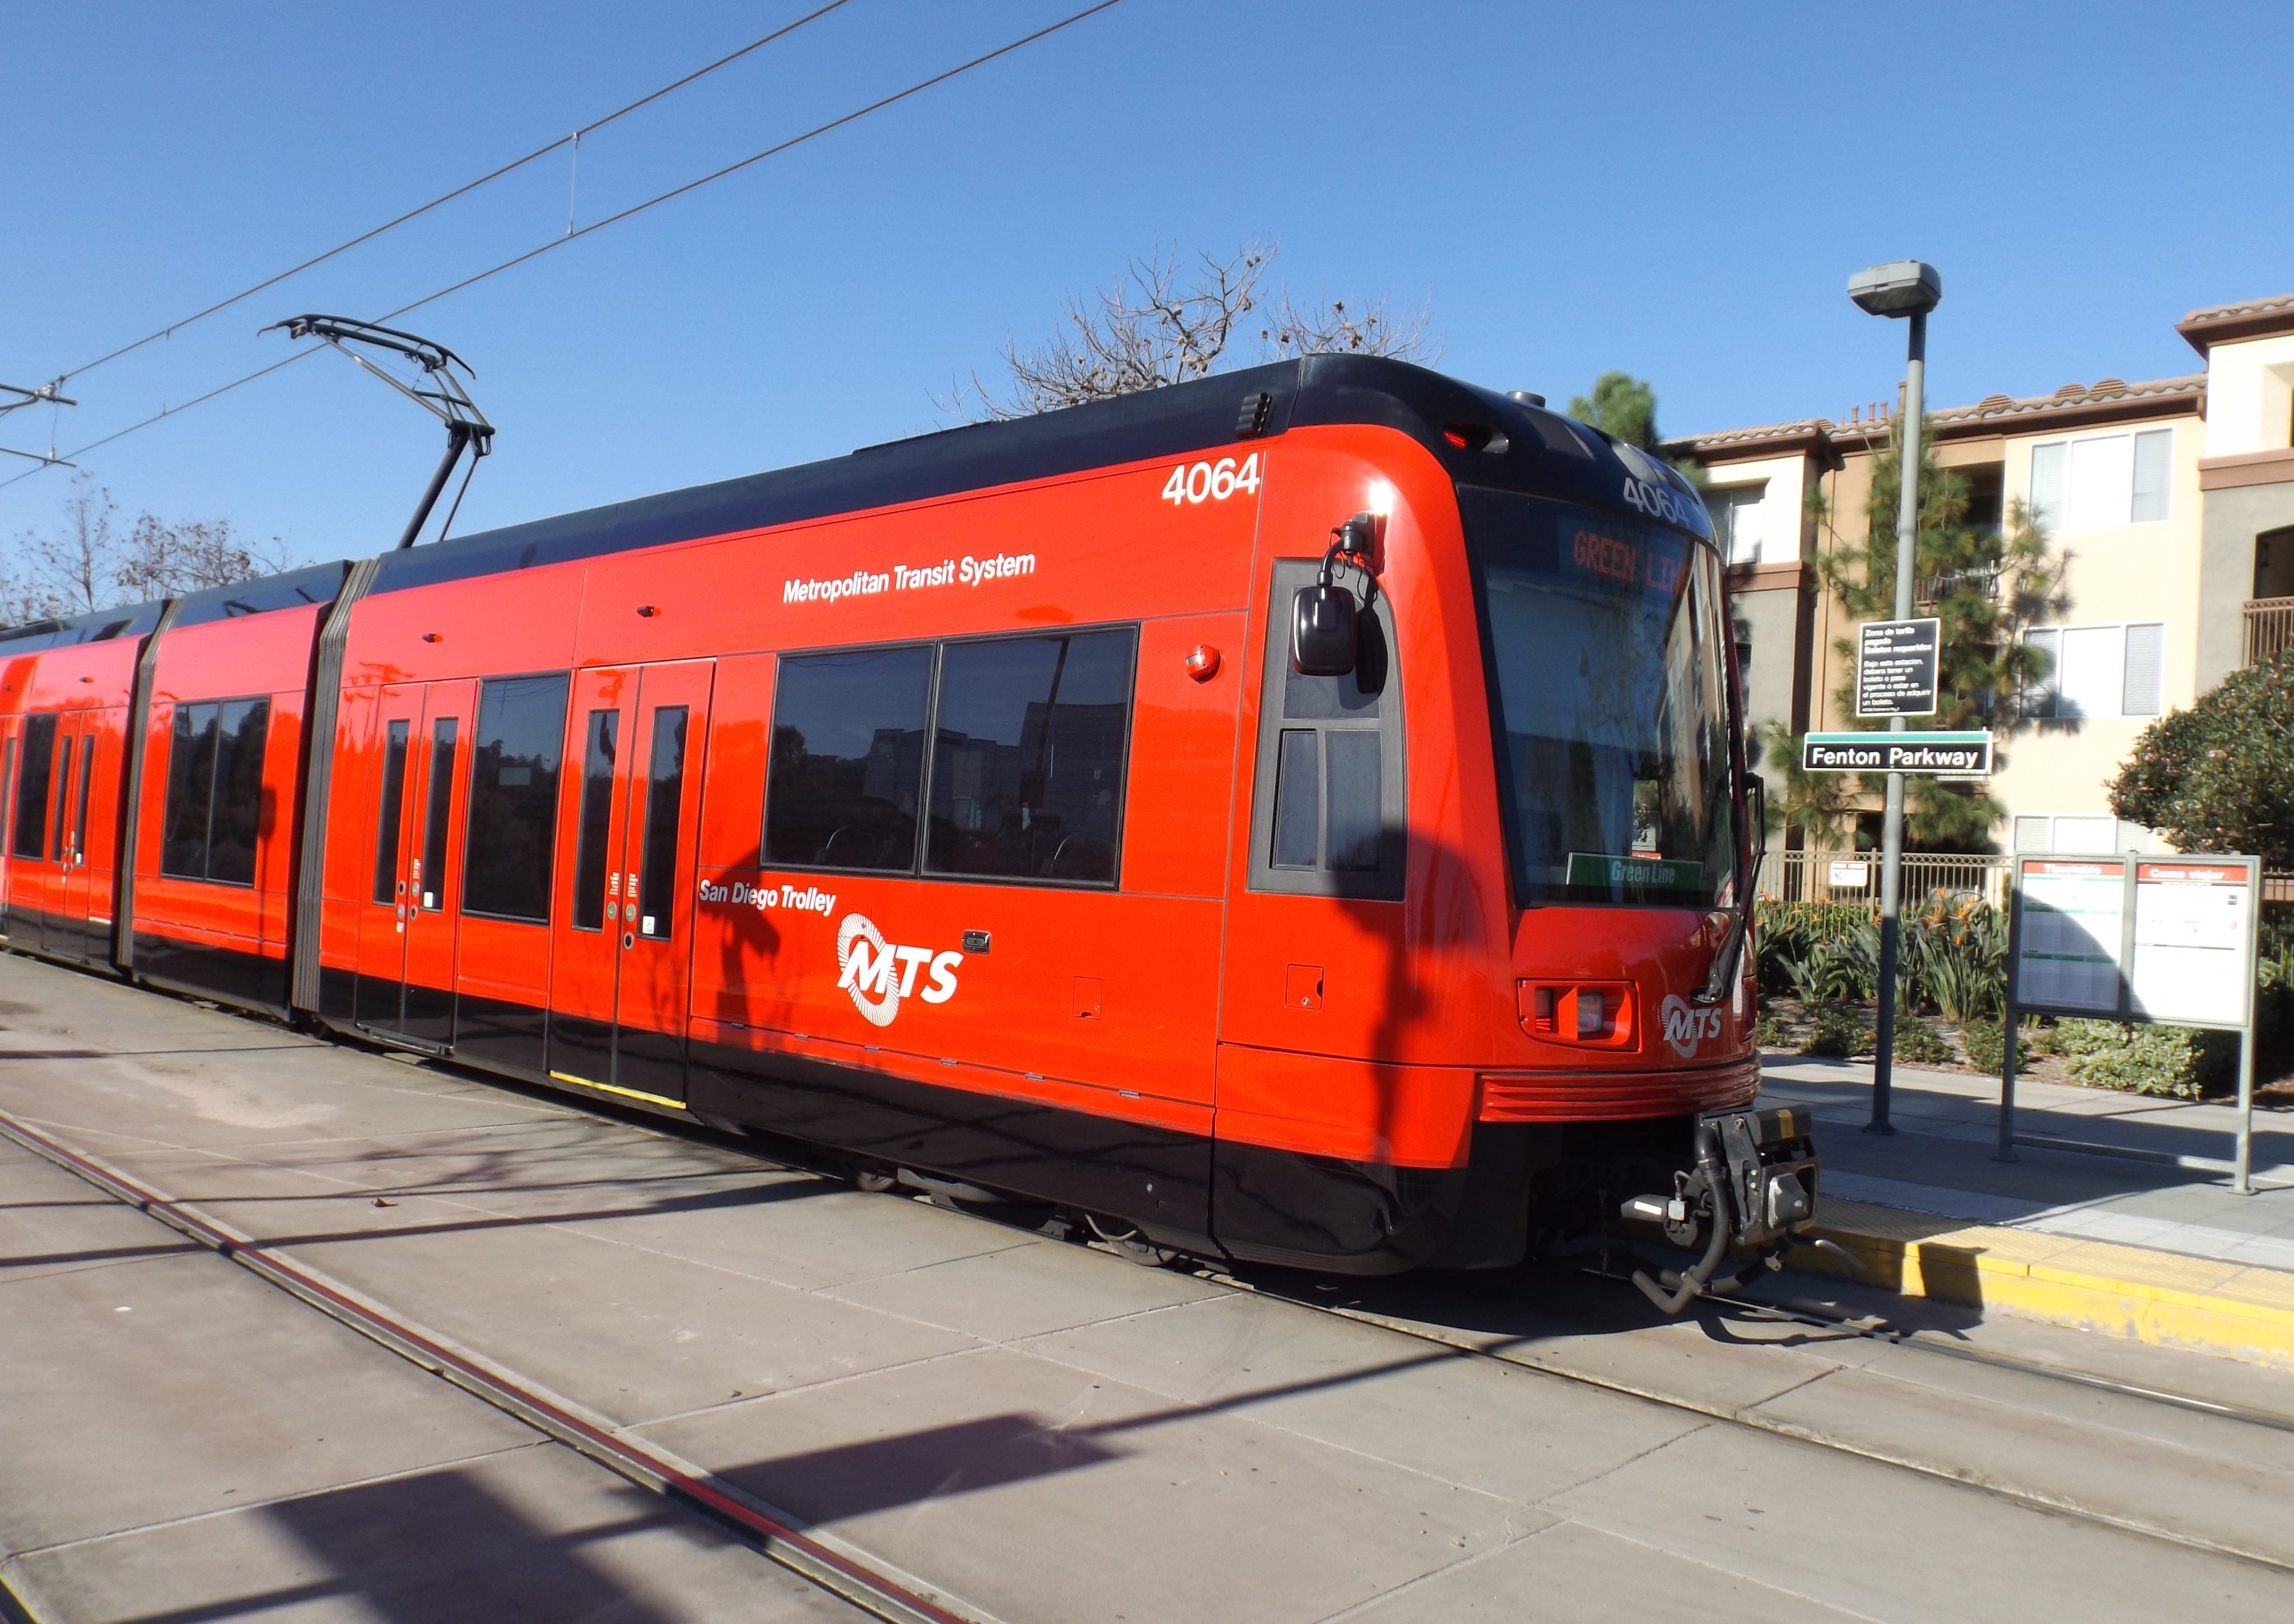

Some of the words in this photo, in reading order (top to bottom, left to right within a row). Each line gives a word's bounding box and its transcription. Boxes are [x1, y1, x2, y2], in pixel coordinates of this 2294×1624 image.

[1162, 452, 1260, 506] 4064
[1623, 477, 1690, 529] 4064
[783, 571, 889, 603] Metropolitan
[894, 559, 956, 590] Transit
[959, 553, 1036, 586] System
[1573, 530, 1638, 581] GREEN
[1645, 552, 1685, 596] LIN
[1864, 646, 1892, 654] Boletos
[1893, 643, 1932, 653] requeridos
[1812, 747, 1880, 765] Fenton
[1889, 747, 1978, 769] Parkway
[1611, 860, 1649, 883] Green
[1652, 863, 1675, 884] Line
[2044, 864, 2102, 875] Timetable
[2150, 868, 2186, 879] Como
[2189, 869, 2225, 881] viajar
[700, 879, 728, 903] San
[731, 882, 777, 911] Diego
[781, 885, 837, 917] Trolley
[837, 941, 964, 1004] MTS
[1662, 1007, 1722, 1042] MTS
